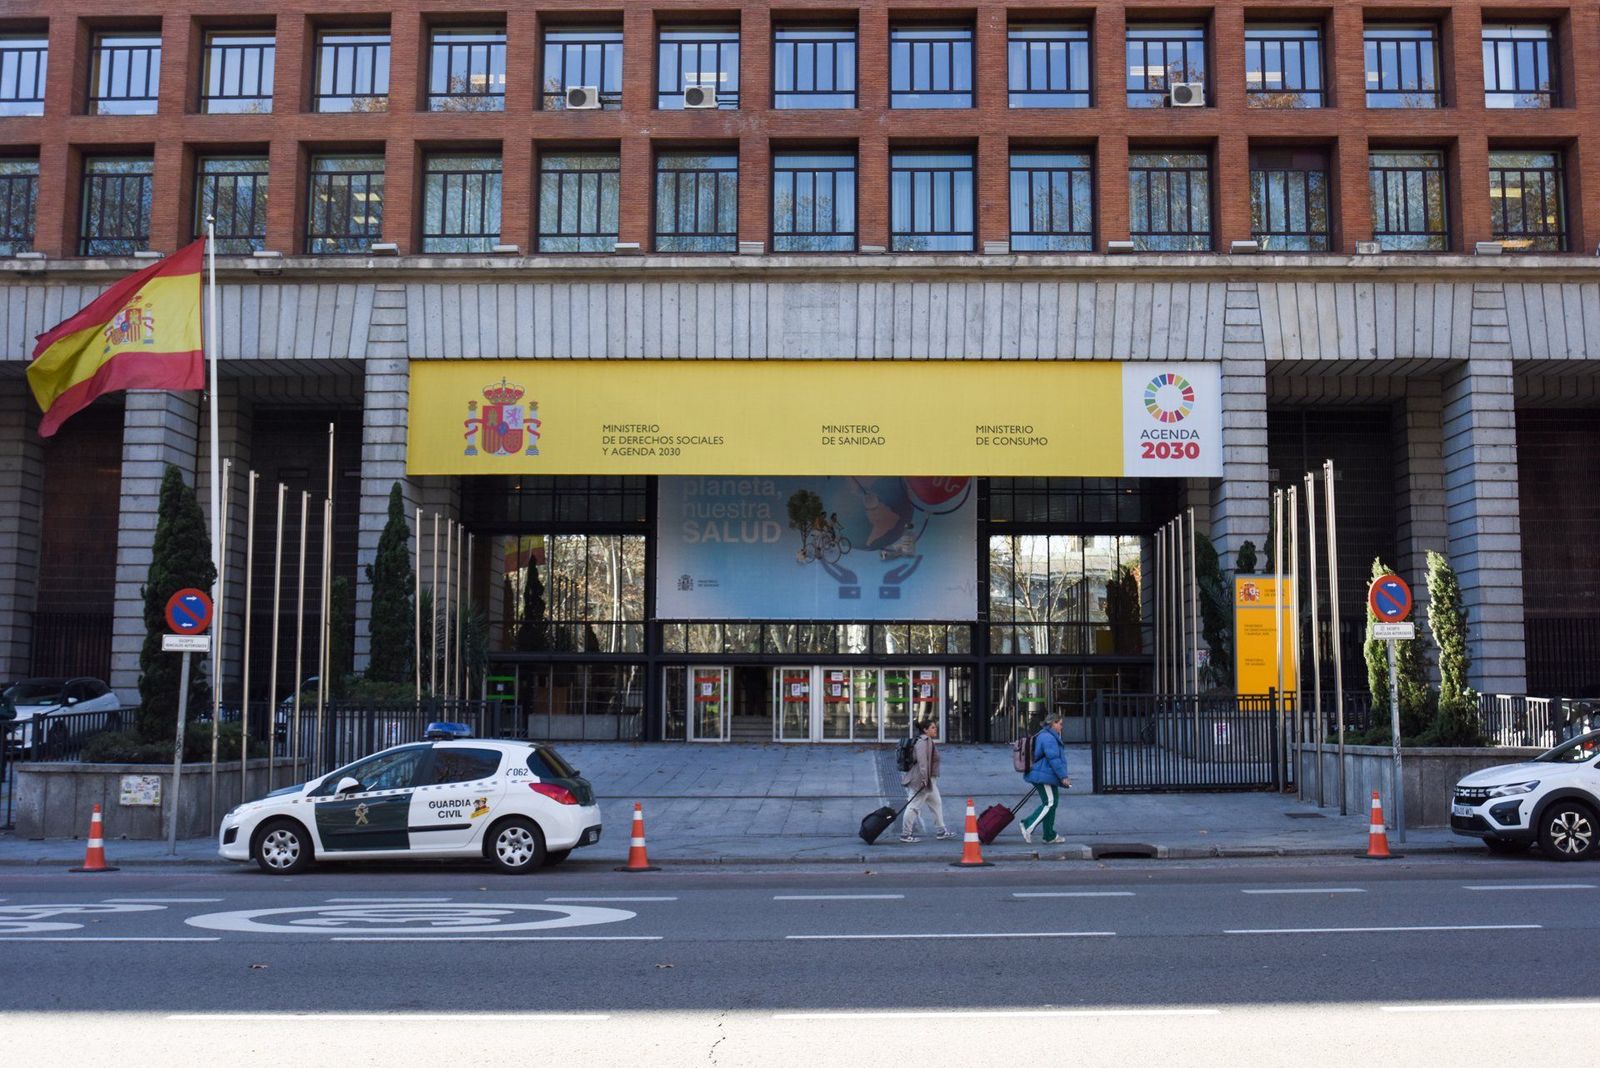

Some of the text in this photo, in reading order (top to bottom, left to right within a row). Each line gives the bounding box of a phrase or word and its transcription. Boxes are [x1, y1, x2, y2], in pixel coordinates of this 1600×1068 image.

[602, 424, 660, 433] MINISTERIO
[822, 424, 880, 434] MINISTERIO
[976, 425, 1034, 434] MINISTERIO
[1140, 429, 1200, 440] AGENDA
[602, 436, 724, 445] DE DERECHOS SOCIALES
[822, 436, 886, 445] DE SANIDAD
[976, 437, 1048, 446] DE CONSUMO
[602, 447, 681, 456] Y AGENDA 2030
[1140, 441, 1200, 460] 2030
[683, 476, 783, 501] planeta,
[683, 500, 772, 518] nuestra
[682, 520, 782, 543] SALUD
[512, 768, 529, 777] 062
[428, 799, 471, 809] GUARDIA
[437, 810, 462, 819] CIVIL
[290, 908, 515, 926] 30
